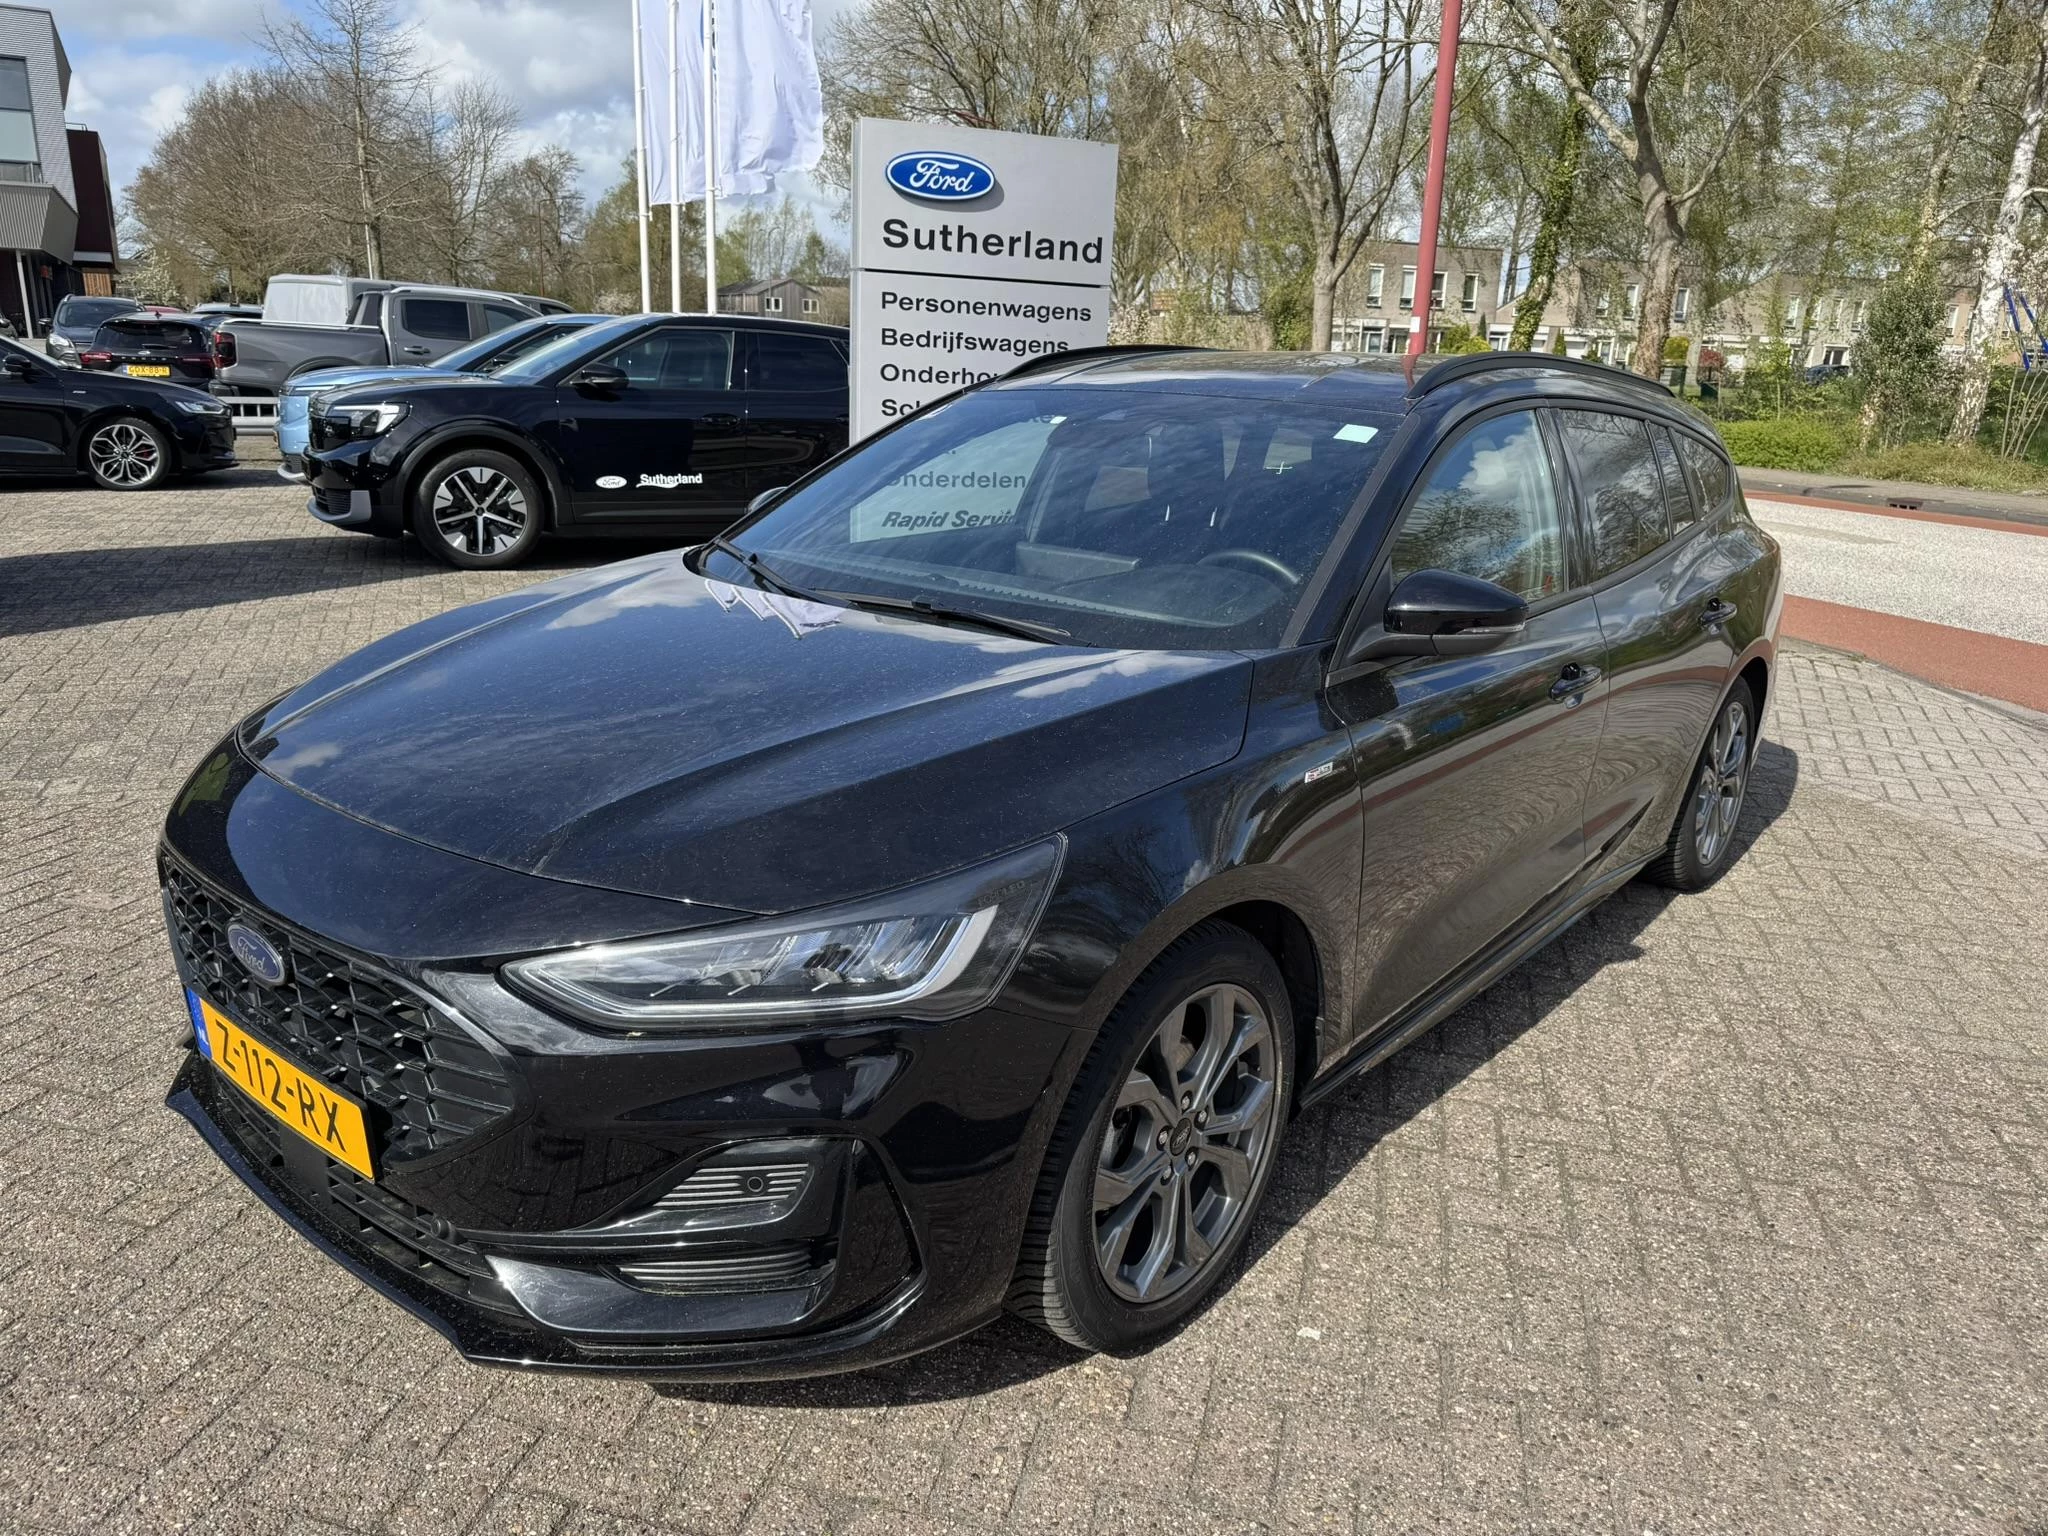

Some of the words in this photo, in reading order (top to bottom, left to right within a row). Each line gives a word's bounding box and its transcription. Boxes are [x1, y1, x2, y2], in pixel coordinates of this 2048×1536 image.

[909, 159, 974, 193] Ford
[883, 219, 1103, 263] Sutherland
[881, 292, 1092, 323] Personenwagens
[881, 328, 1069, 356] Bedrijfswagens
[880, 364, 998, 385] Onderho
[640, 473, 703, 485] Sutherland
[882, 511, 949, 531] Rapid
[237, 936, 267, 972] Ford
[215, 1018, 347, 1153] Z-112-RX
